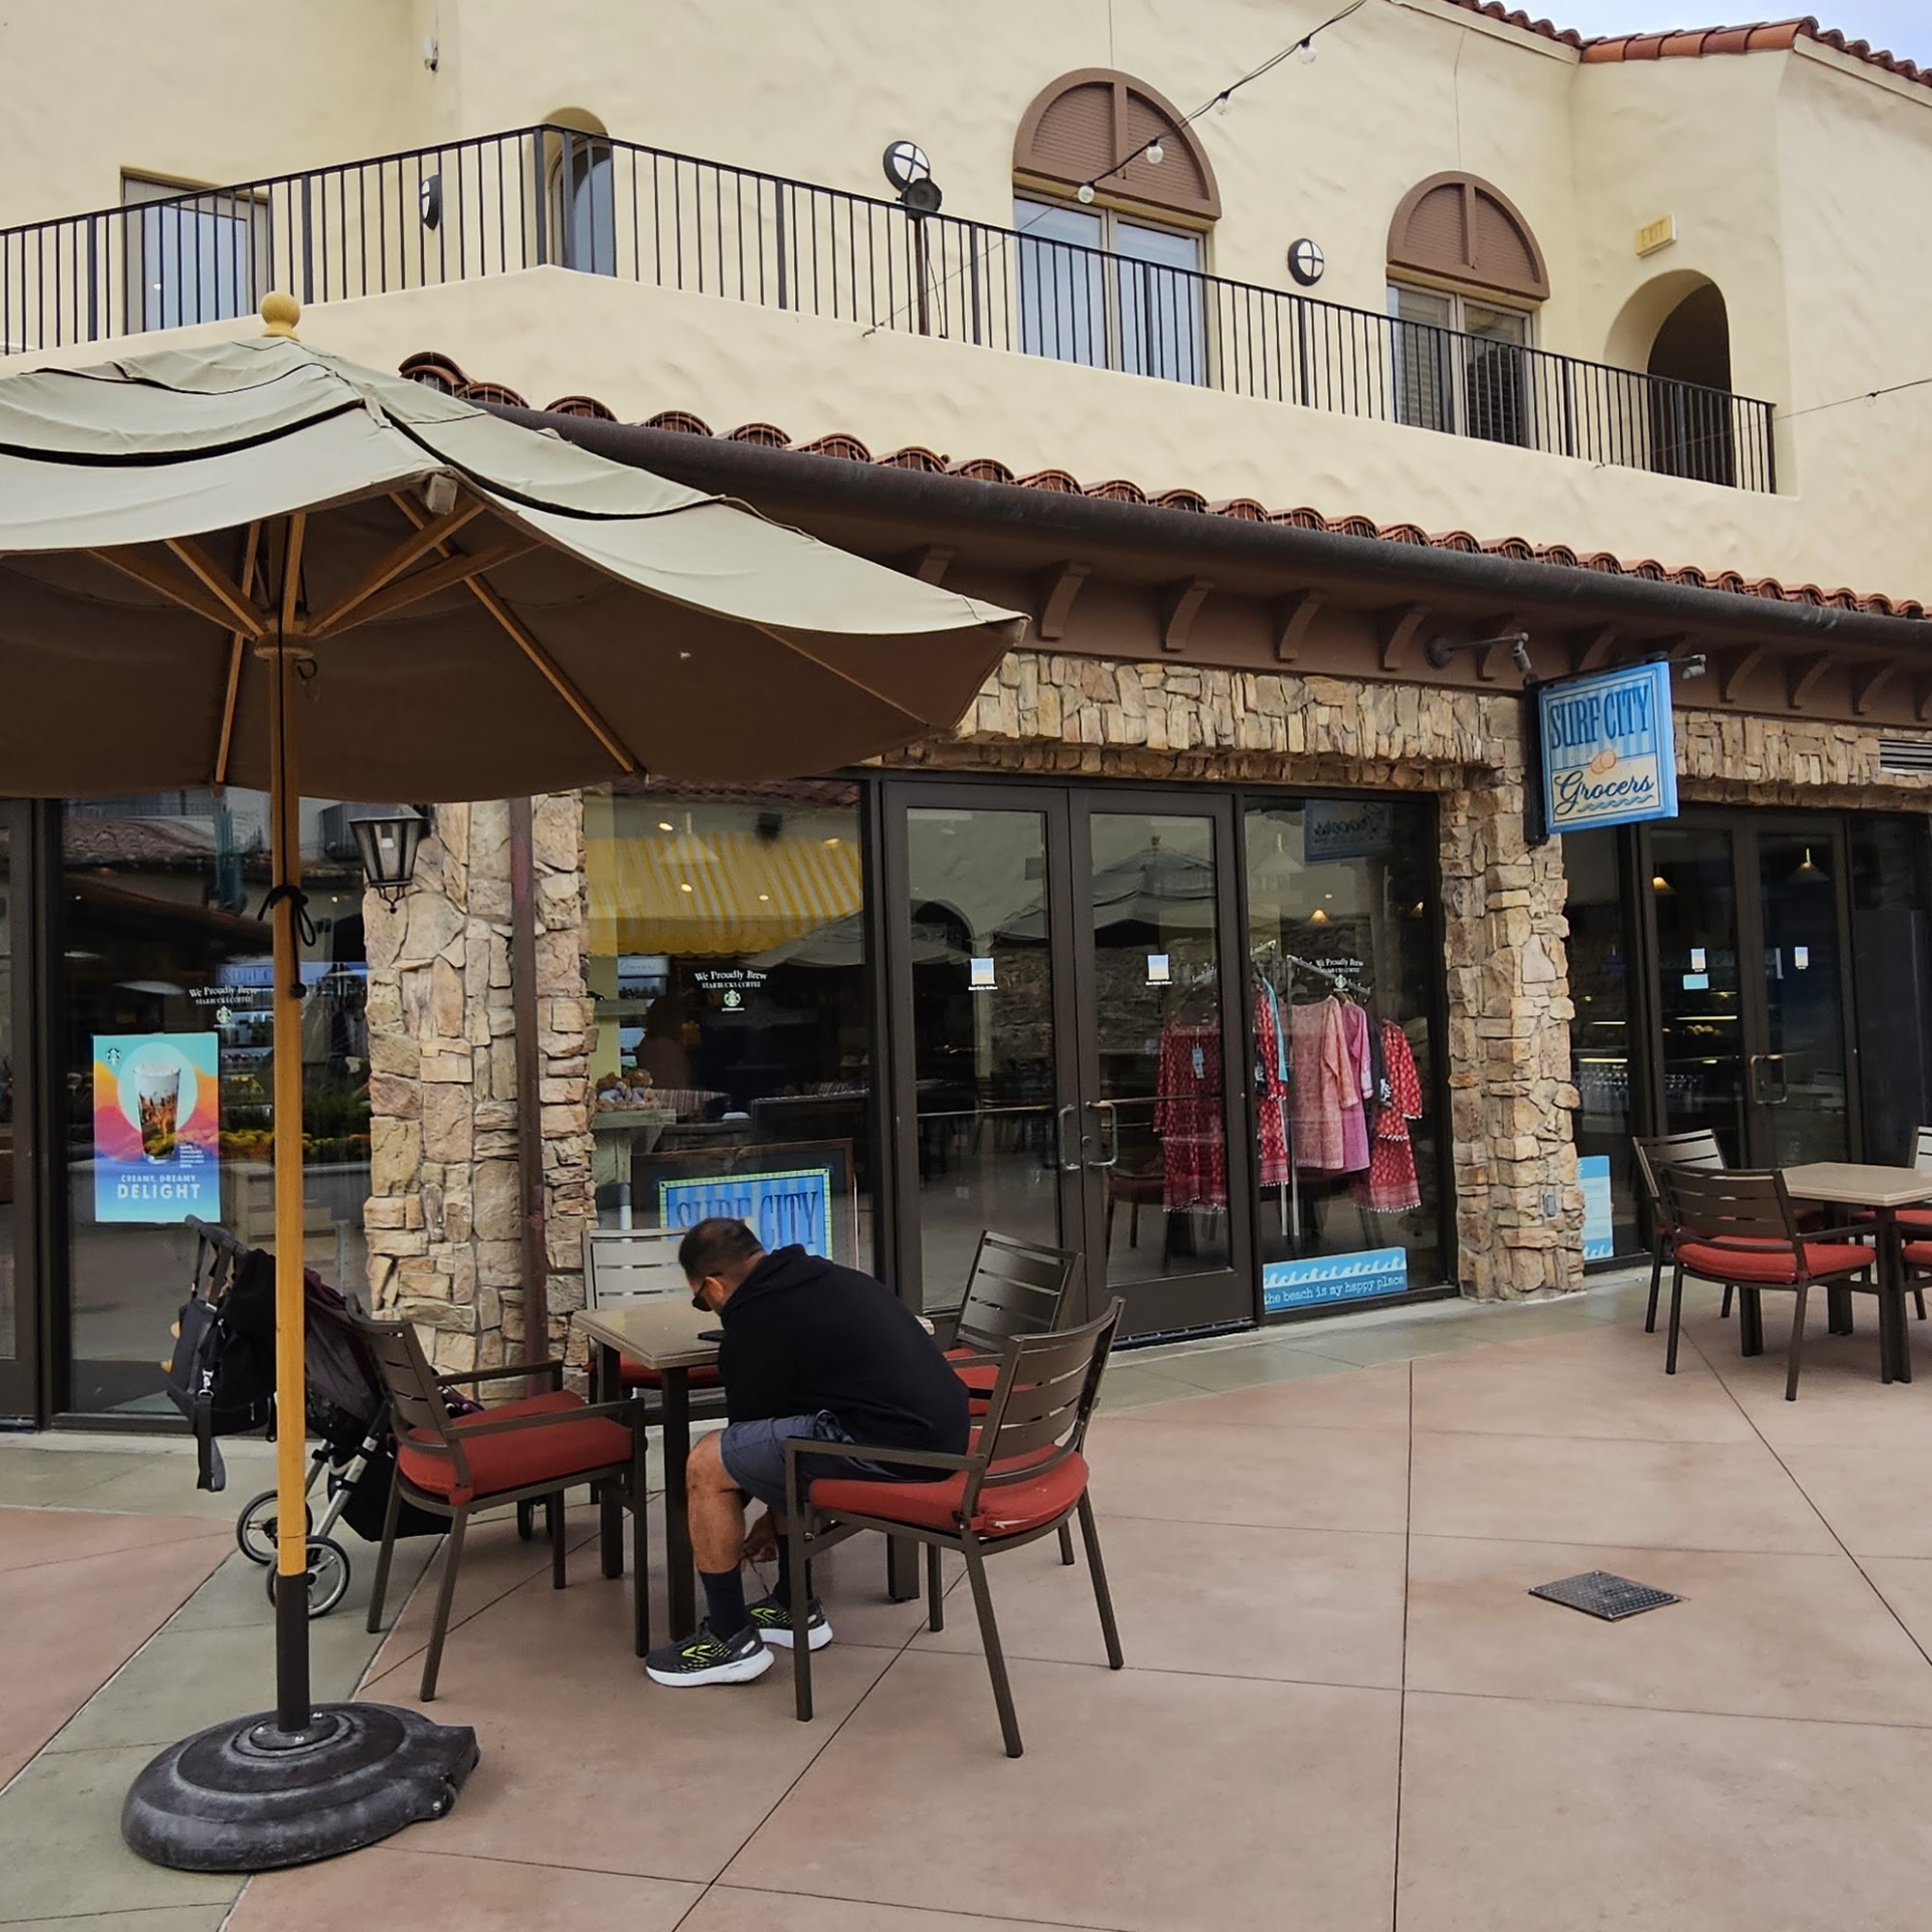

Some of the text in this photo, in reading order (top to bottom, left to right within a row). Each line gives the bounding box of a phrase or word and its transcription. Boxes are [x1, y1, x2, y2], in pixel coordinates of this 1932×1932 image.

[1549, 685, 1649, 750] SURF CITY
[1553, 770, 1655, 816] Grocers
[695, 970, 768, 981] We Proudly Brew
[188, 987, 202, 998] We
[204, 984, 235, 996] Proudly
[159, 1174, 196, 1183] DREAMY
[117, 1183, 201, 1200] DELIGHT
[759, 1191, 818, 1255] CITY
[1264, 1274, 1405, 1305] the beach is my happy place
